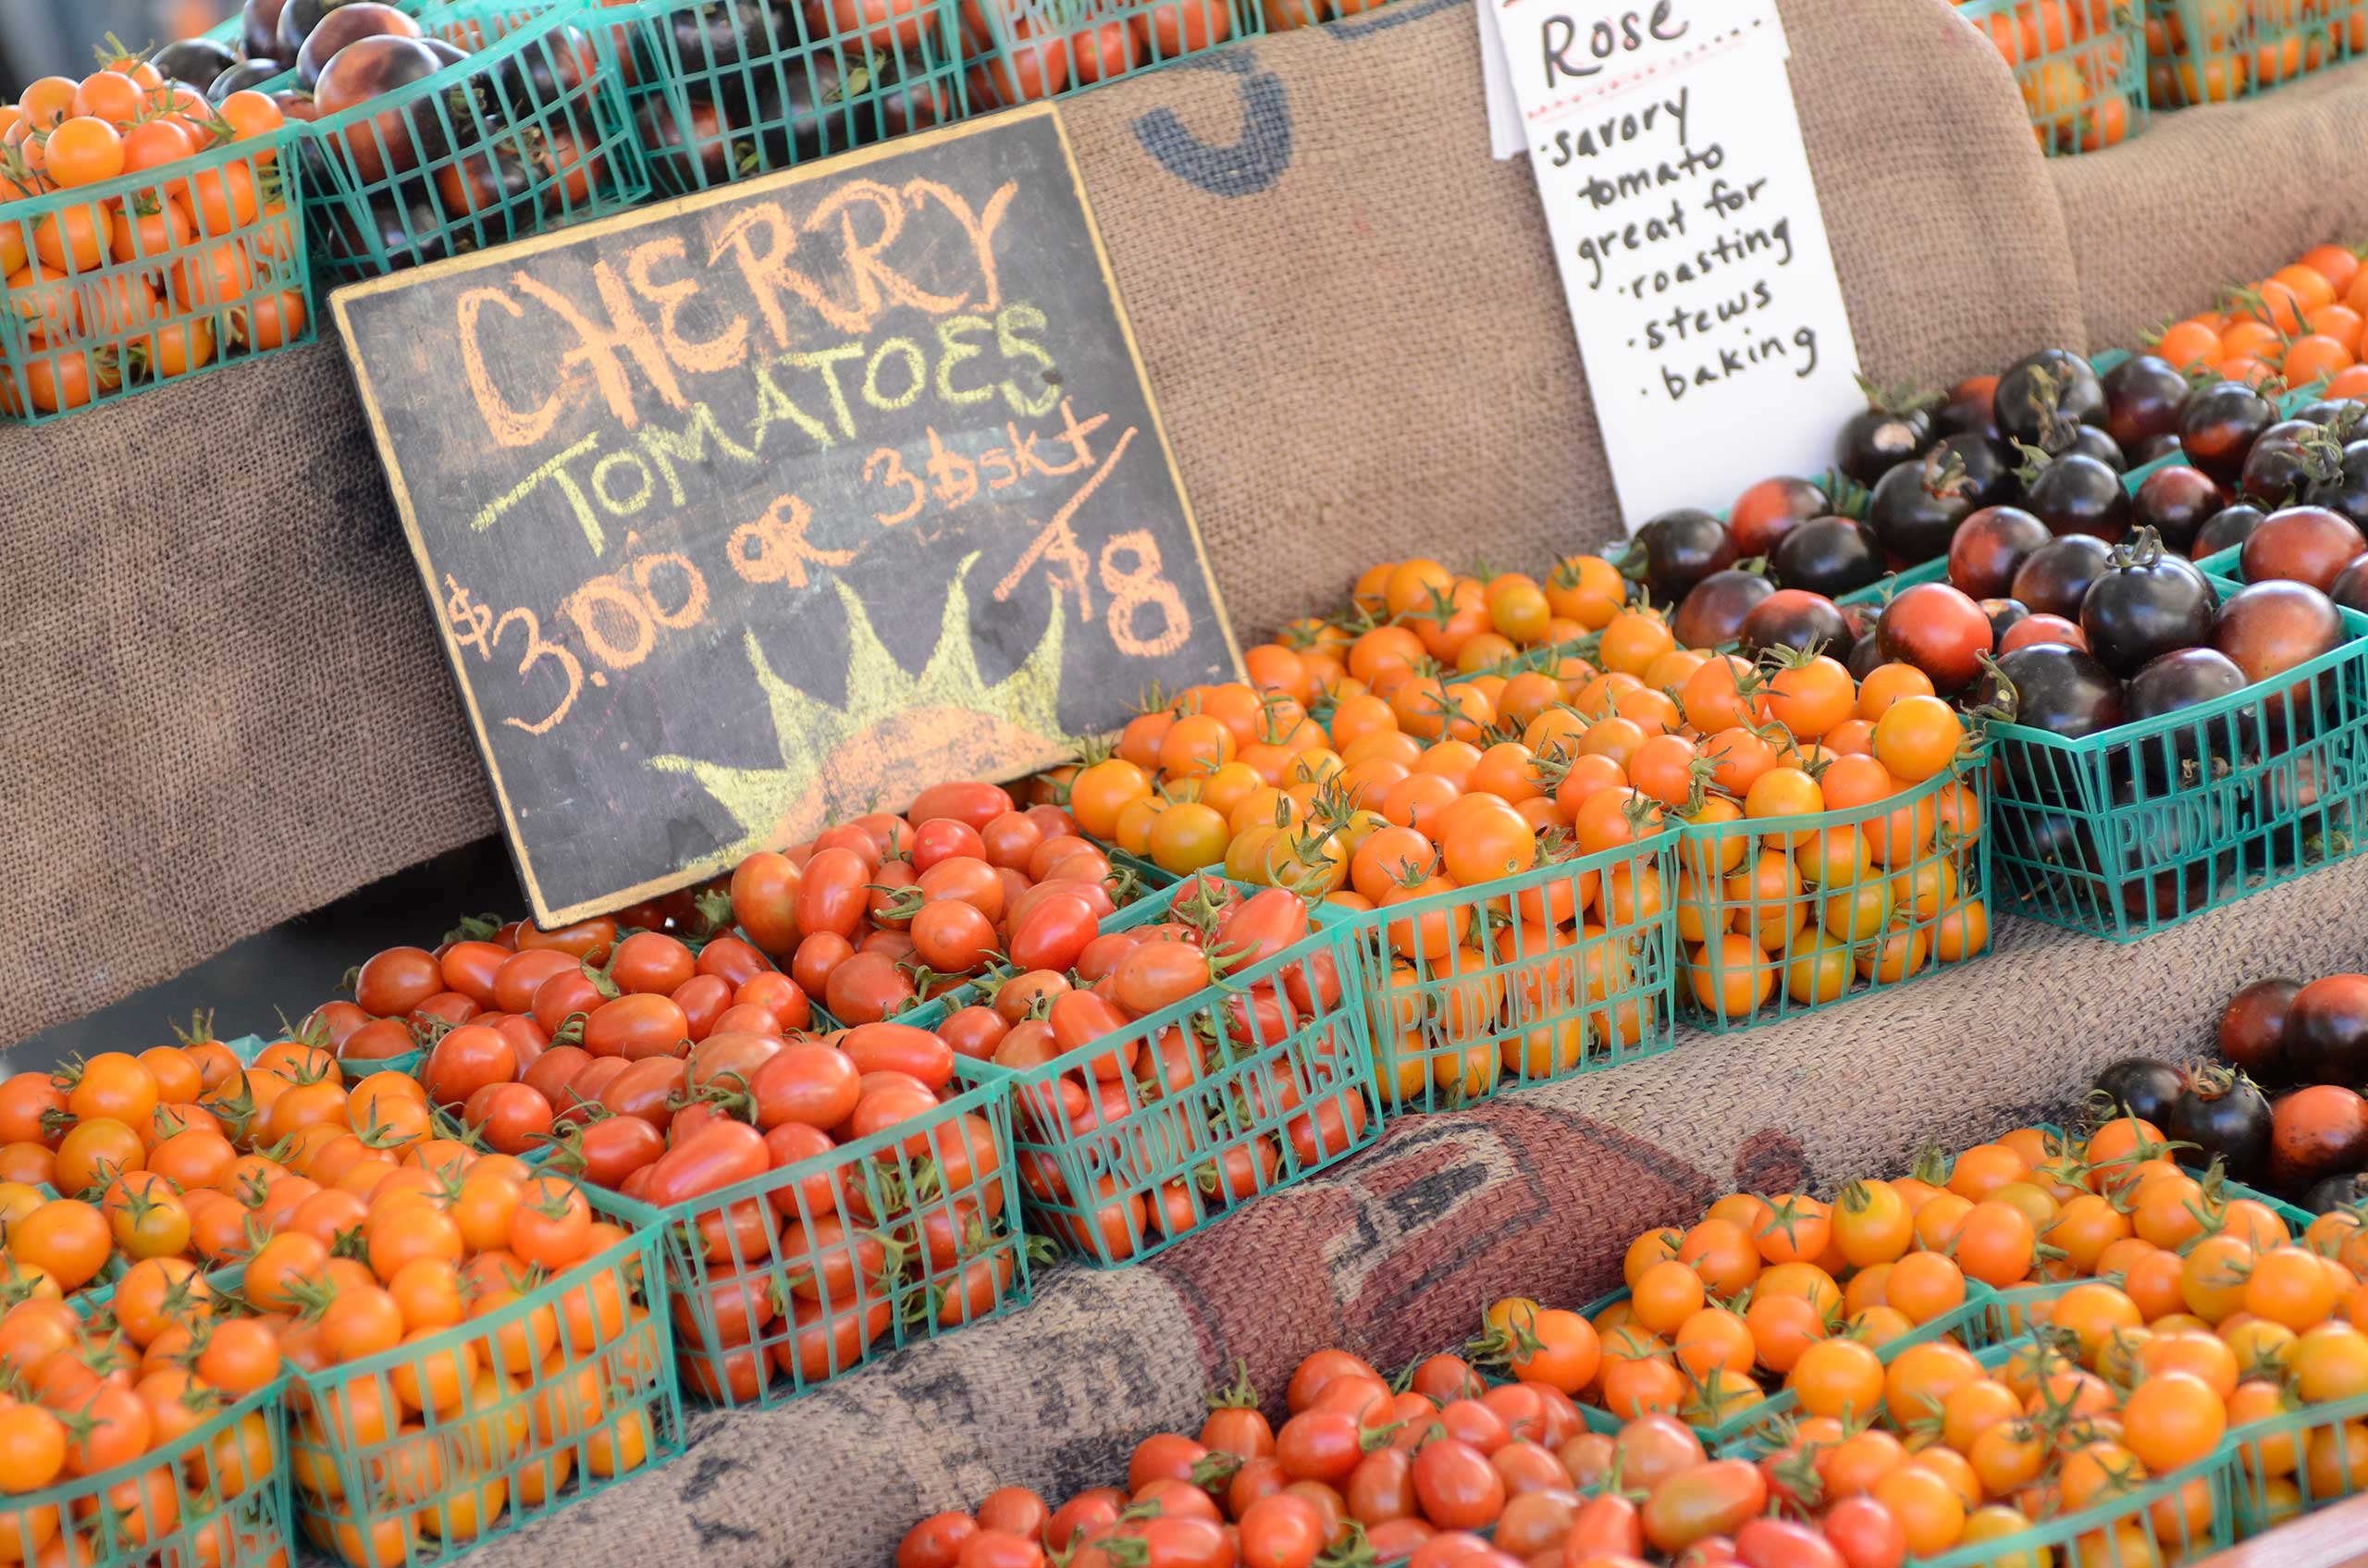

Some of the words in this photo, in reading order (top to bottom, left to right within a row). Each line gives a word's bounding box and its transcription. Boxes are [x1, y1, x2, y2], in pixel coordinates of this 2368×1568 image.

[1540, 0, 1689, 88] Rose
[1551, 86, 1689, 167] savory
[1578, 142, 1725, 209] tomato
[12, 260, 177, 359] PRODUCT
[184, 241, 229, 312] OF
[234, 215, 302, 297] USA
[1578, 199, 1686, 290] great
[1703, 177, 1768, 219] for
[1631, 216, 1793, 300] roasting
[457, 178, 1018, 448] CHERRY
[1646, 280, 1772, 351] stews
[1660, 326, 1818, 401] baking
[471, 302, 1064, 557] TOMATOES
[2115, 770, 2266, 877] PRODUCT
[2270, 751, 2309, 822] OF
[1397, 960, 1552, 1055] PRODUCT
[1559, 945, 1598, 1011] OF
[1602, 923, 1666, 999] USA
[1080, 1080, 1240, 1203] PRODUCT
[1241, 1053, 1289, 1127] OF
[1289, 1016, 1363, 1103] USA
[366, 1399, 537, 1516] PRODUCT
[596, 1323, 664, 1422] USA
